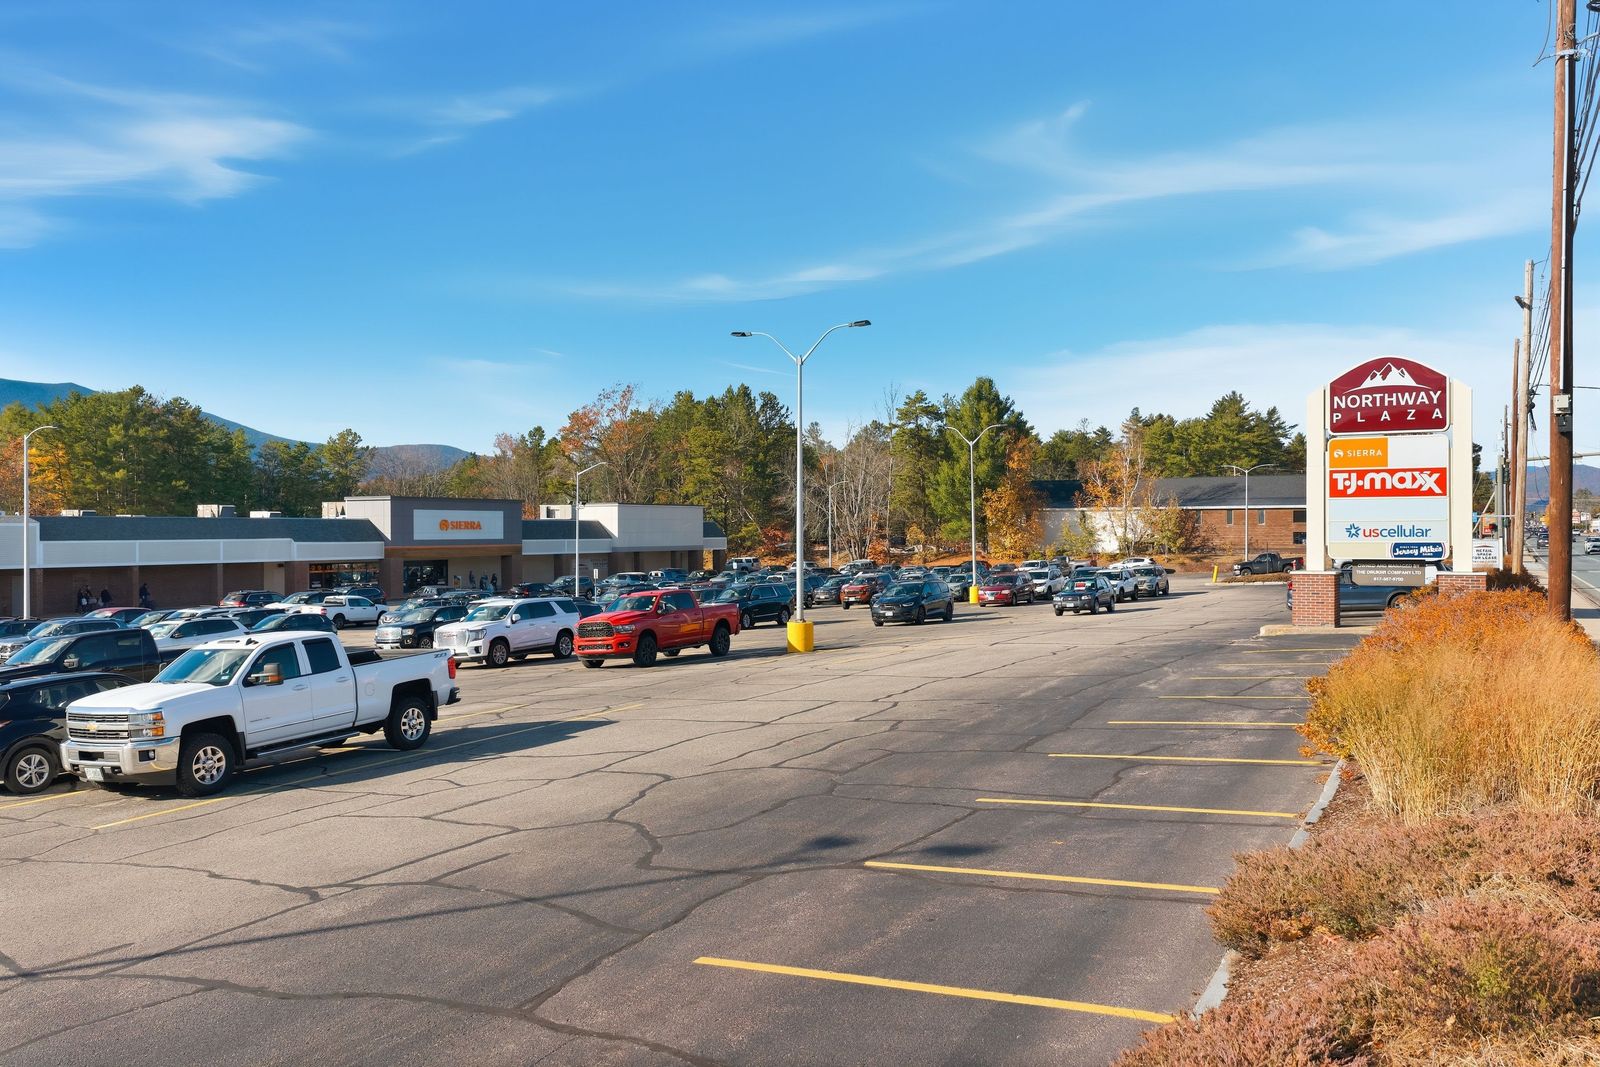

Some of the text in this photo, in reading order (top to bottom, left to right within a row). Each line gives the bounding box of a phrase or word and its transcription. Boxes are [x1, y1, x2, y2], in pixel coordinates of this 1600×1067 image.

[1333, 390, 1442, 409] NORTHWAY
[1333, 408, 1443, 423] PLAZA
[1347, 449, 1382, 457] SIERRA
[450, 520, 482, 530] SIERRA
[1363, 525, 1431, 538] uscellular
[1394, 548, 1419, 556] Jersey
